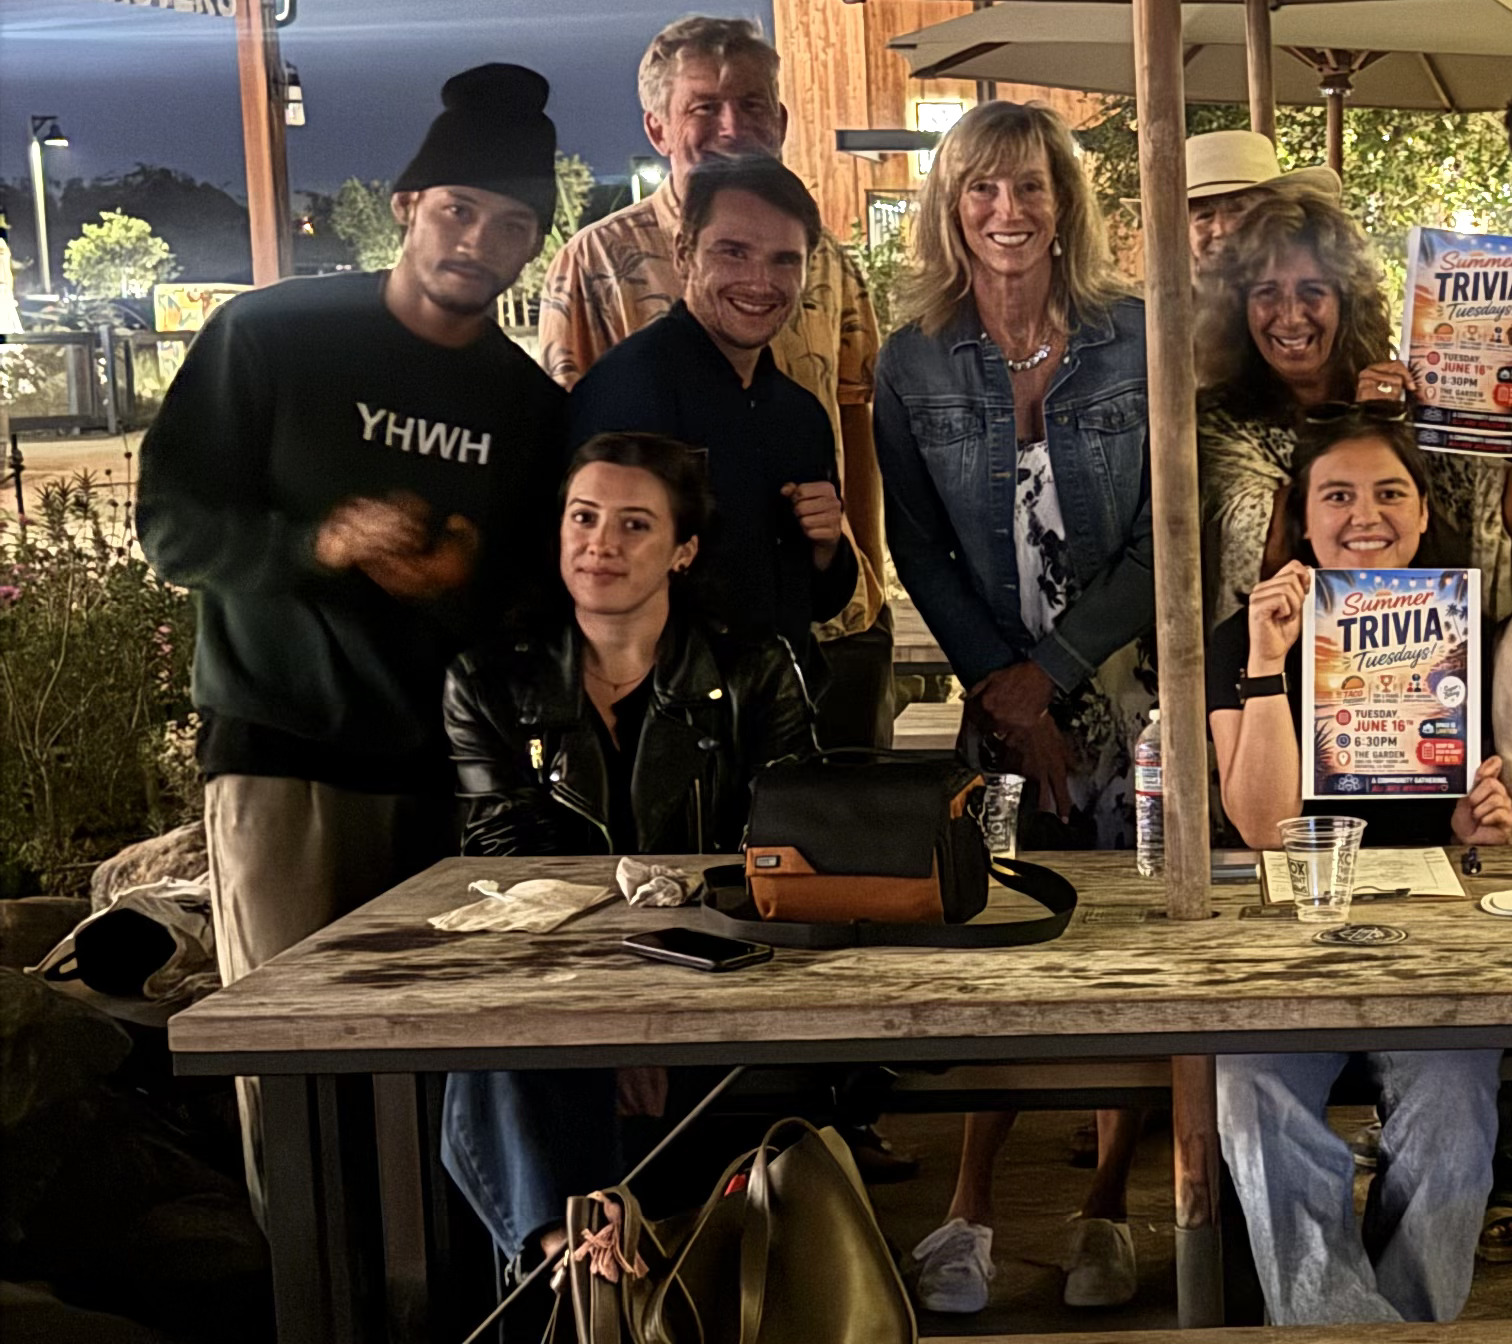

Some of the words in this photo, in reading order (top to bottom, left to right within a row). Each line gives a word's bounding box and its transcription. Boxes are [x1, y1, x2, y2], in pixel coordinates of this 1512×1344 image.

[1441, 362, 1470, 374] JUNE
[1440, 387, 1453, 395] THE
[1455, 388, 1484, 398] GARDEN
[356, 402, 492, 465] YHWH
[1342, 591, 1435, 616] Summer
[1337, 607, 1444, 653] TRIVIA
[1353, 642, 1438, 673] Tuesdays!
[1343, 690, 1364, 698] TACO
[1354, 720, 1388, 732] JUNE
[1354, 736, 1398, 747] 6:30PM
[1372, 750, 1405, 759] GARDEN
